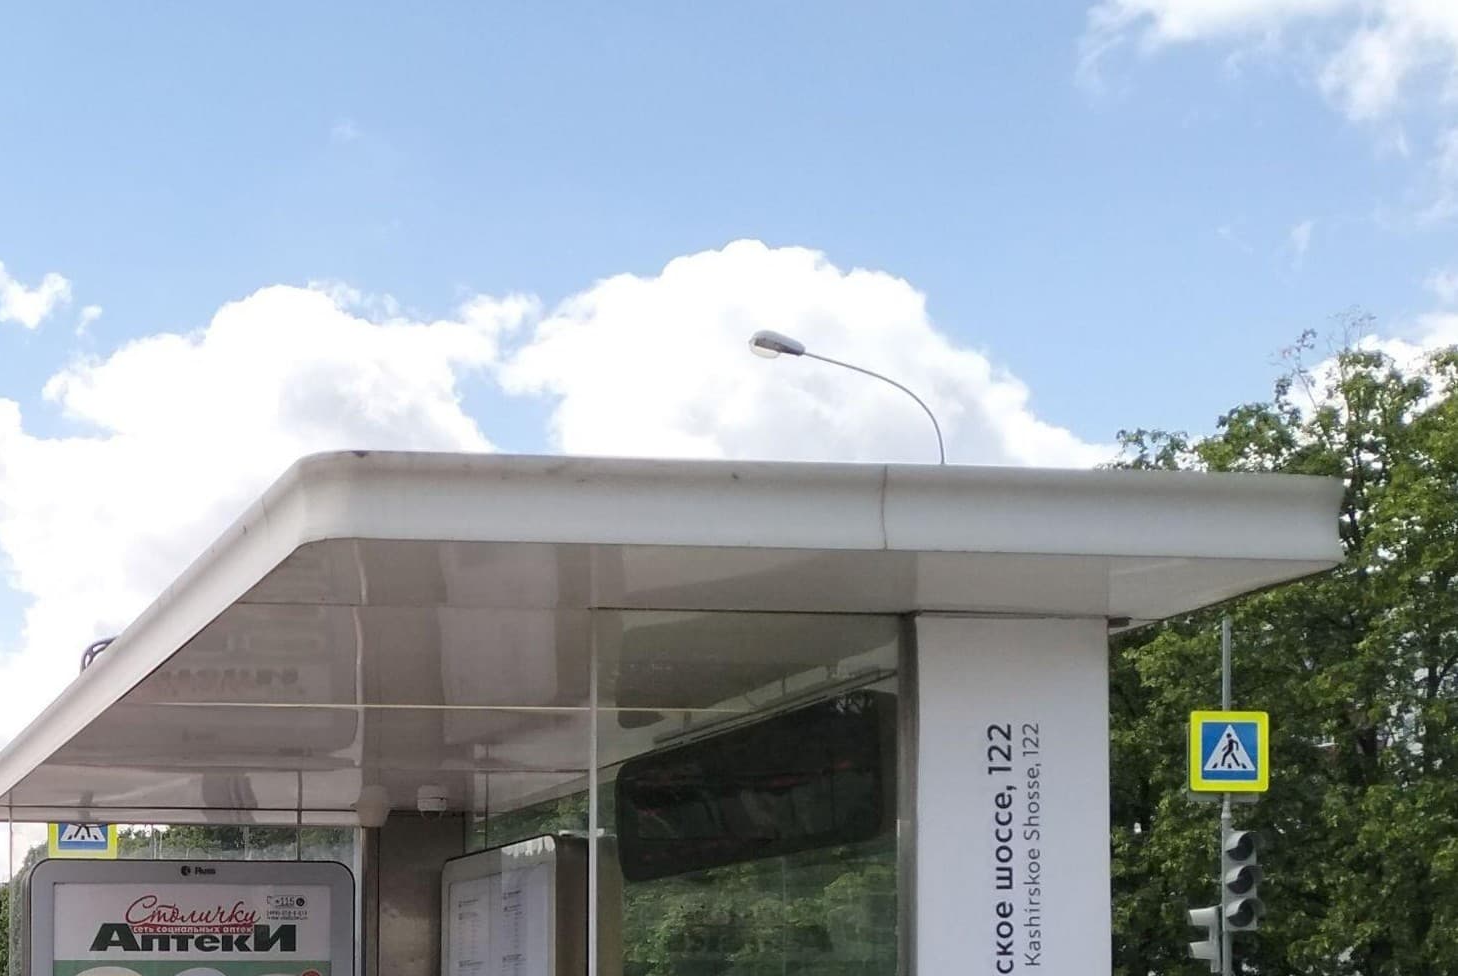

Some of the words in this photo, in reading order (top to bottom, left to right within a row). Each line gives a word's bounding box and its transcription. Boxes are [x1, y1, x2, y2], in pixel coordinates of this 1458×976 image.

[988, 722, 1013, 775] 122
[1022, 722, 1040, 757] 122
[1023, 762, 1041, 841] Shosse,
[994, 784, 1017, 890] шоссе,
[125, 895, 261, 925] Столички
[133, 926, 154, 934] сеть
[156, 926, 220, 935] социальных
[223, 926, 253, 934] аптек
[1024, 848, 1041, 966] Kashirskoe
